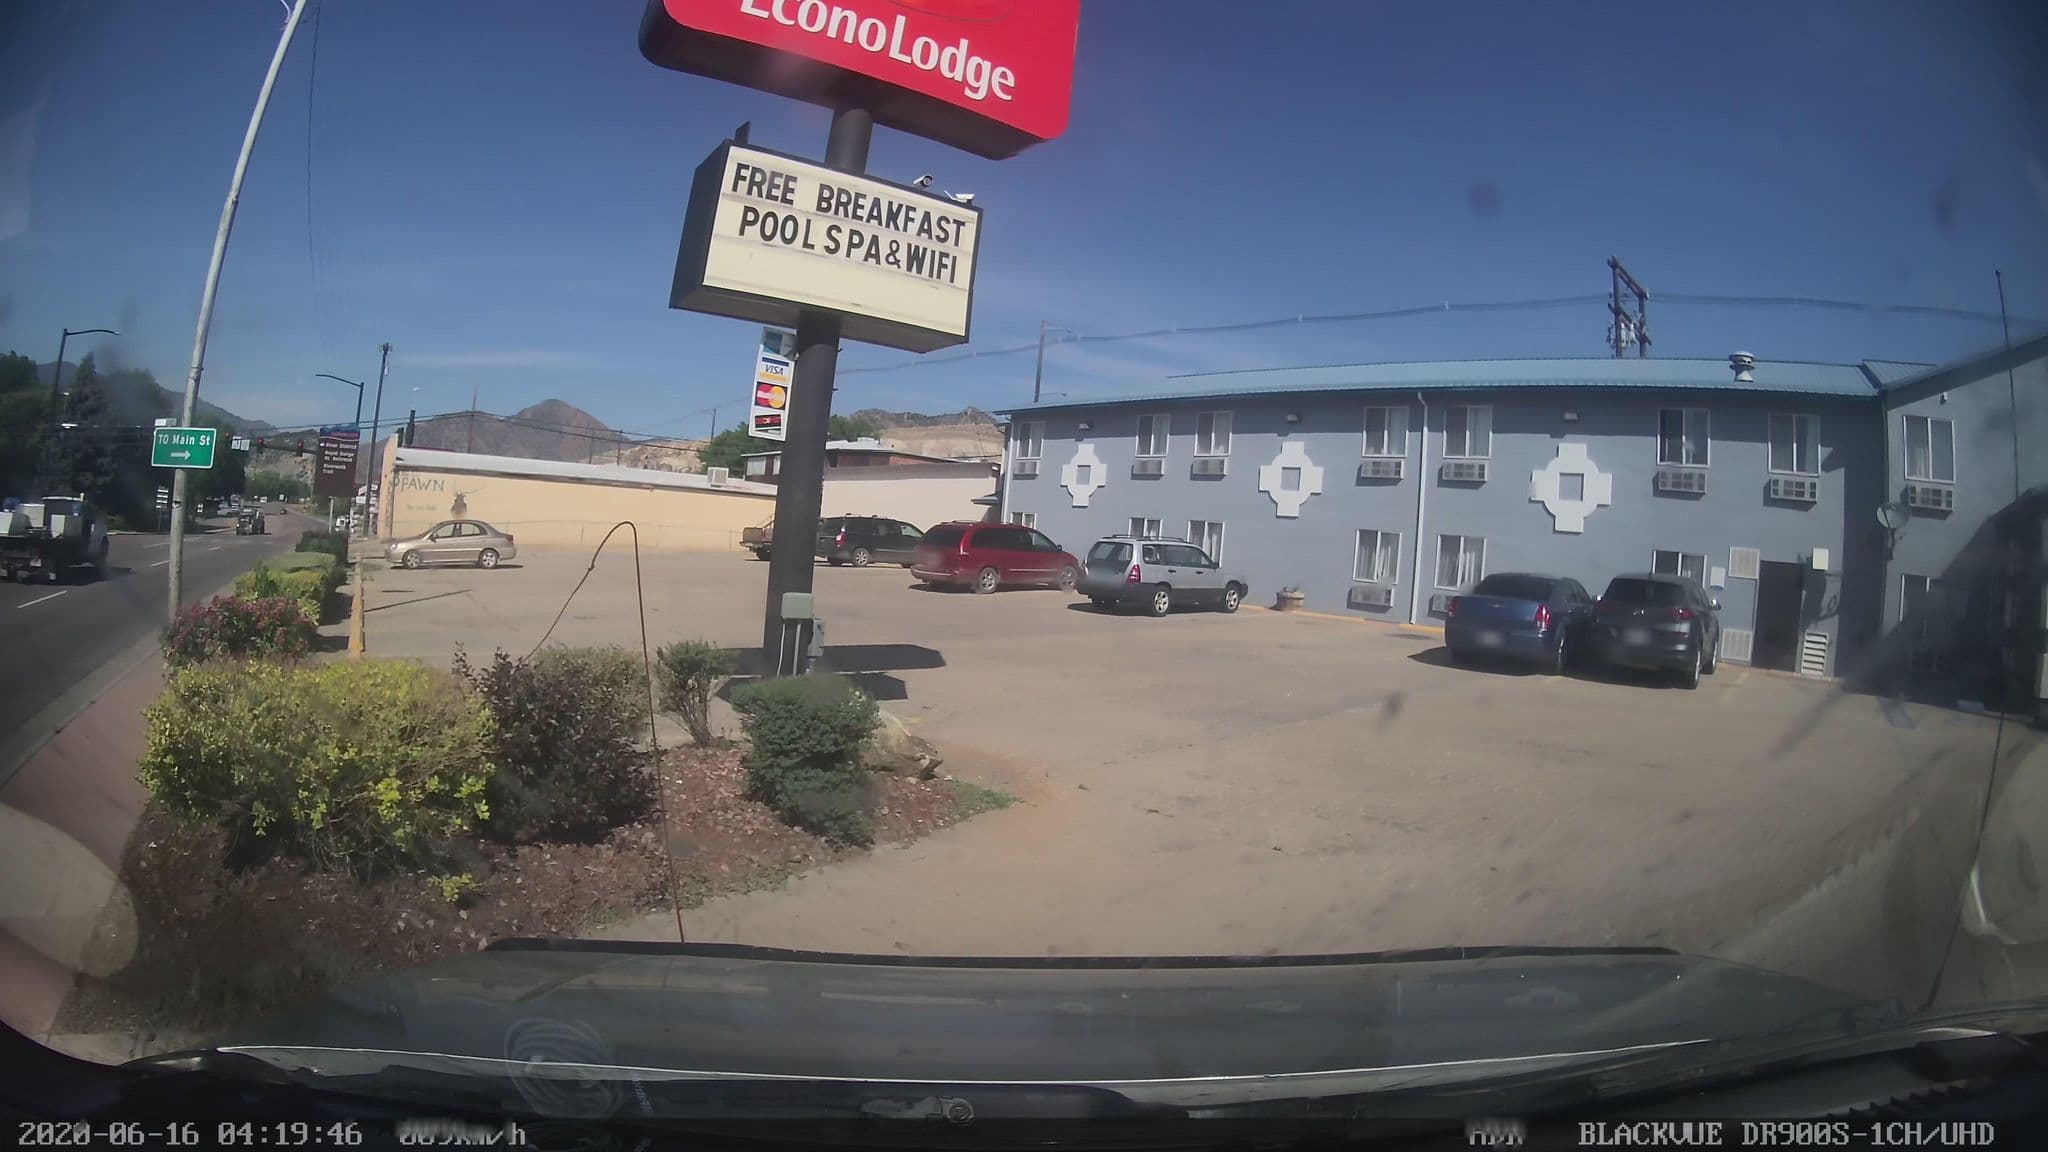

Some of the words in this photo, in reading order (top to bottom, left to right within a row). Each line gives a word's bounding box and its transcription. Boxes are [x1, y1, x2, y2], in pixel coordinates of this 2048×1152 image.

[731, 163, 798, 205] FREE
[815, 183, 967, 247] BREAKFAST
[738, 206, 815, 250] POOL
[765, 364, 784, 375] VISA
[172, 434, 195, 445] Main
[200, 435, 210, 446] St
